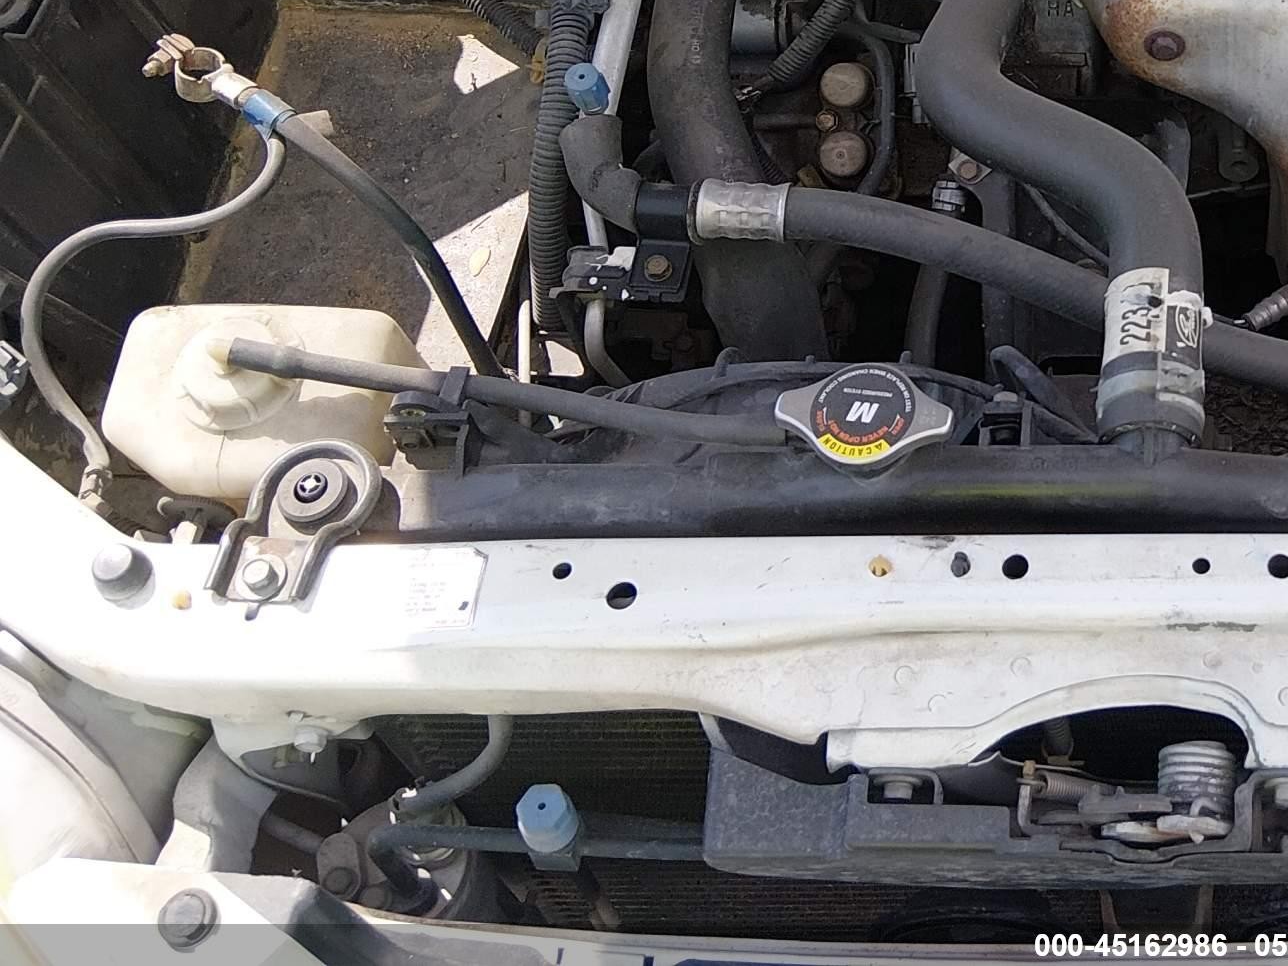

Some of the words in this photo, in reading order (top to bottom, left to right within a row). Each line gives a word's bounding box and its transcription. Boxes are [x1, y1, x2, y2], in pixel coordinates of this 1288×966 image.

[837, 369, 868, 382] CHANGING
[887, 373, 906, 391] REPLACE
[818, 380, 838, 403] COOLANT
[846, 401, 880, 423] M
[823, 437, 872, 456] CAUTION
